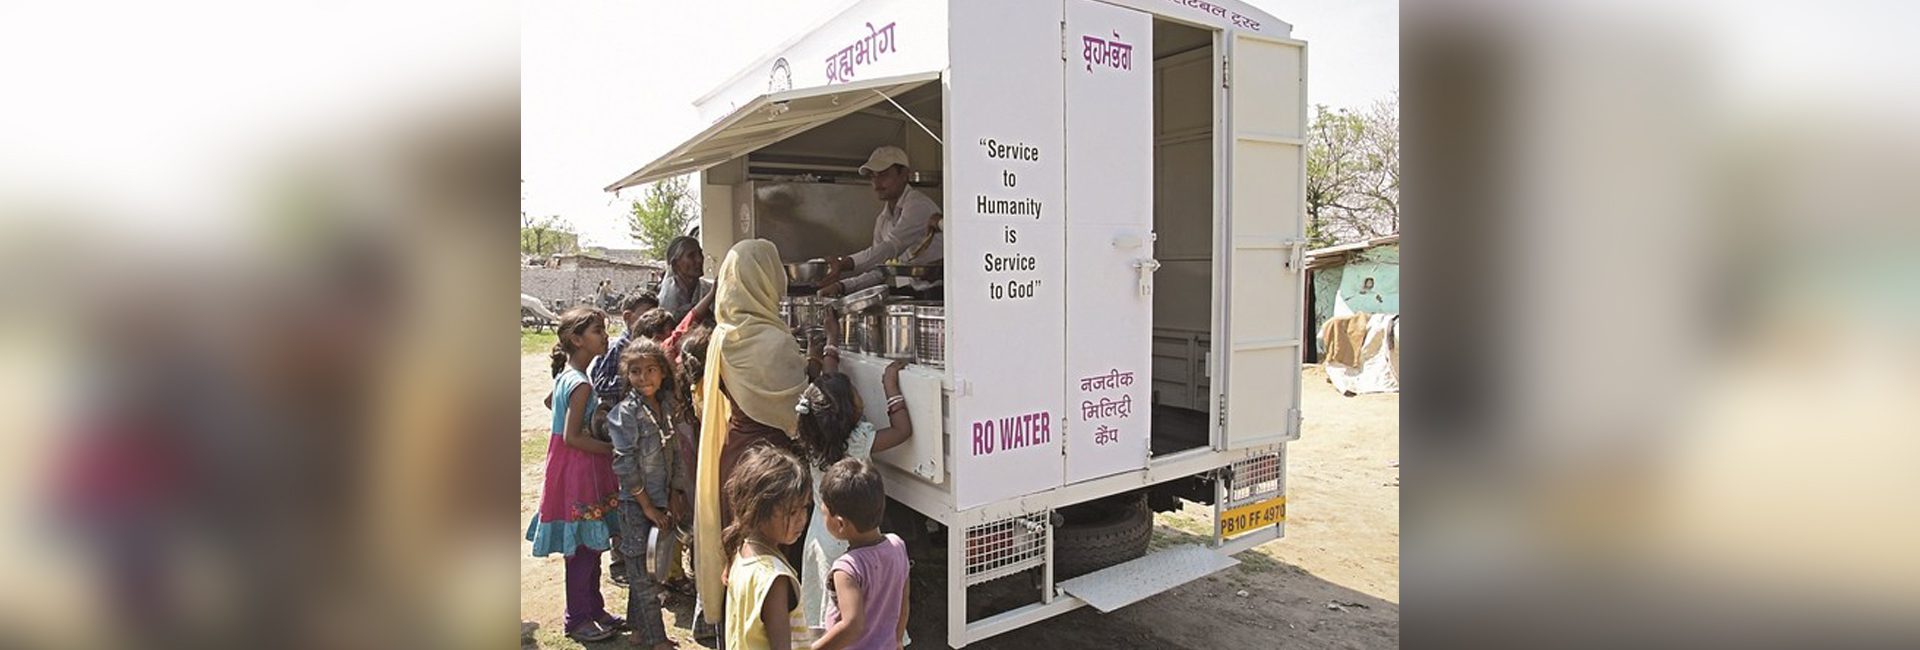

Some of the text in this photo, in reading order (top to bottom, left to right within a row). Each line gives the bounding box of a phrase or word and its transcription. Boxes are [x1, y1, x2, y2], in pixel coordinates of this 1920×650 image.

[1231, 11, 1260, 31] ट्रस्ट
[825, 21, 896, 87] ब्रह्मभोग
[979, 138, 1039, 161] “Service
[1003, 169, 1016, 187] to
[977, 195, 1042, 219] Humanity
[1005, 225, 1017, 243] is
[984, 253, 1036, 272] Service
[990, 280, 1042, 299] to God”
[1080, 368, 1134, 392] नजदीक
[1082, 394, 1131, 421] मिलिट्री
[973, 411, 1050, 456] RO WATER
[1095, 424, 1118, 445] कैंप
[1221, 502, 1286, 535] PB10 FF 4970
